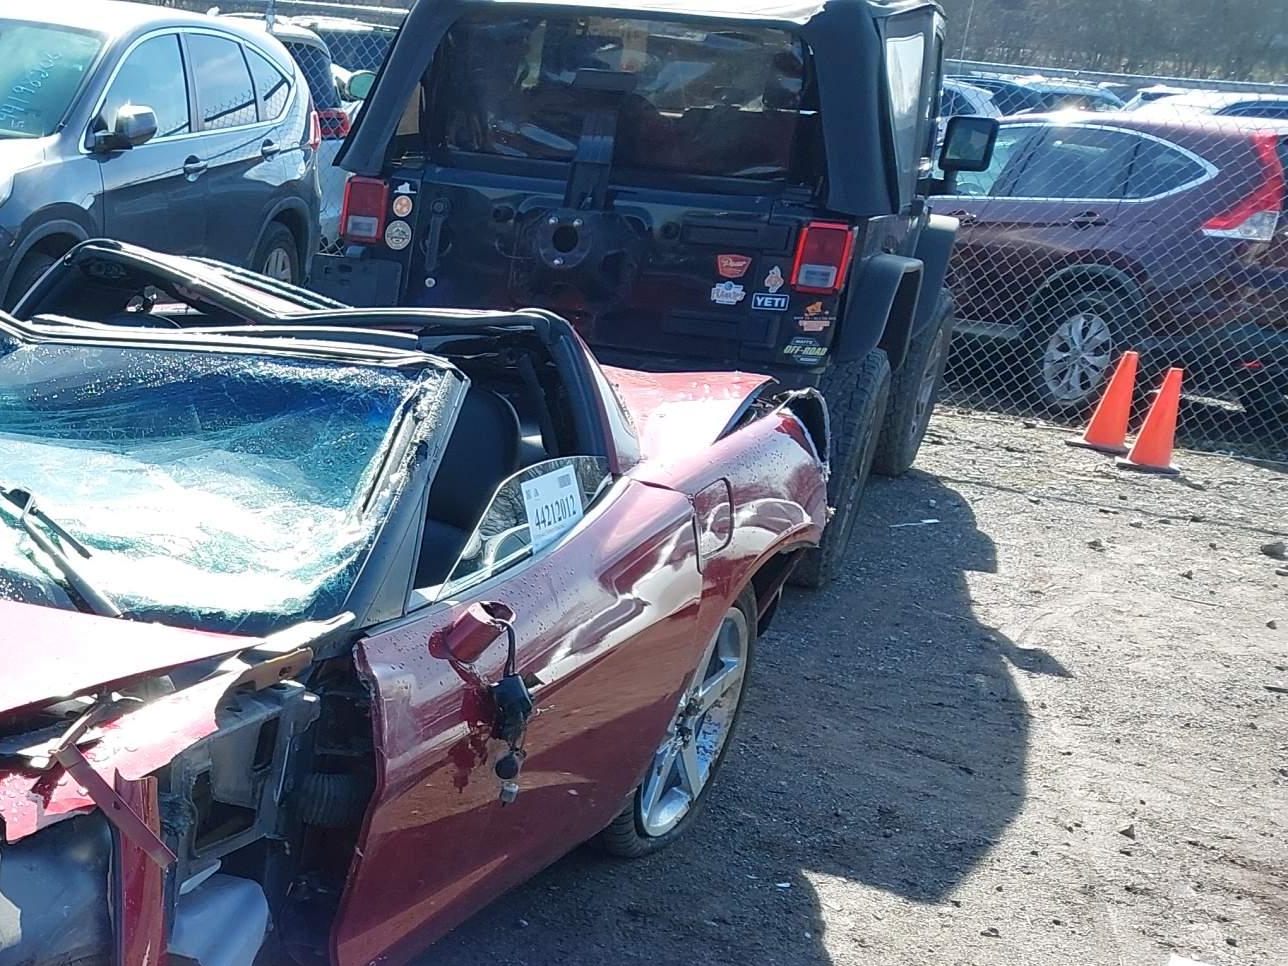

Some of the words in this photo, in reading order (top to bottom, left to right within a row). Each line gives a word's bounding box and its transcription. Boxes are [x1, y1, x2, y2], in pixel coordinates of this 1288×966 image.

[755, 297, 786, 308] YETI
[783, 345, 828, 356] OFF-ROAD
[534, 494, 577, 531] 44212012
